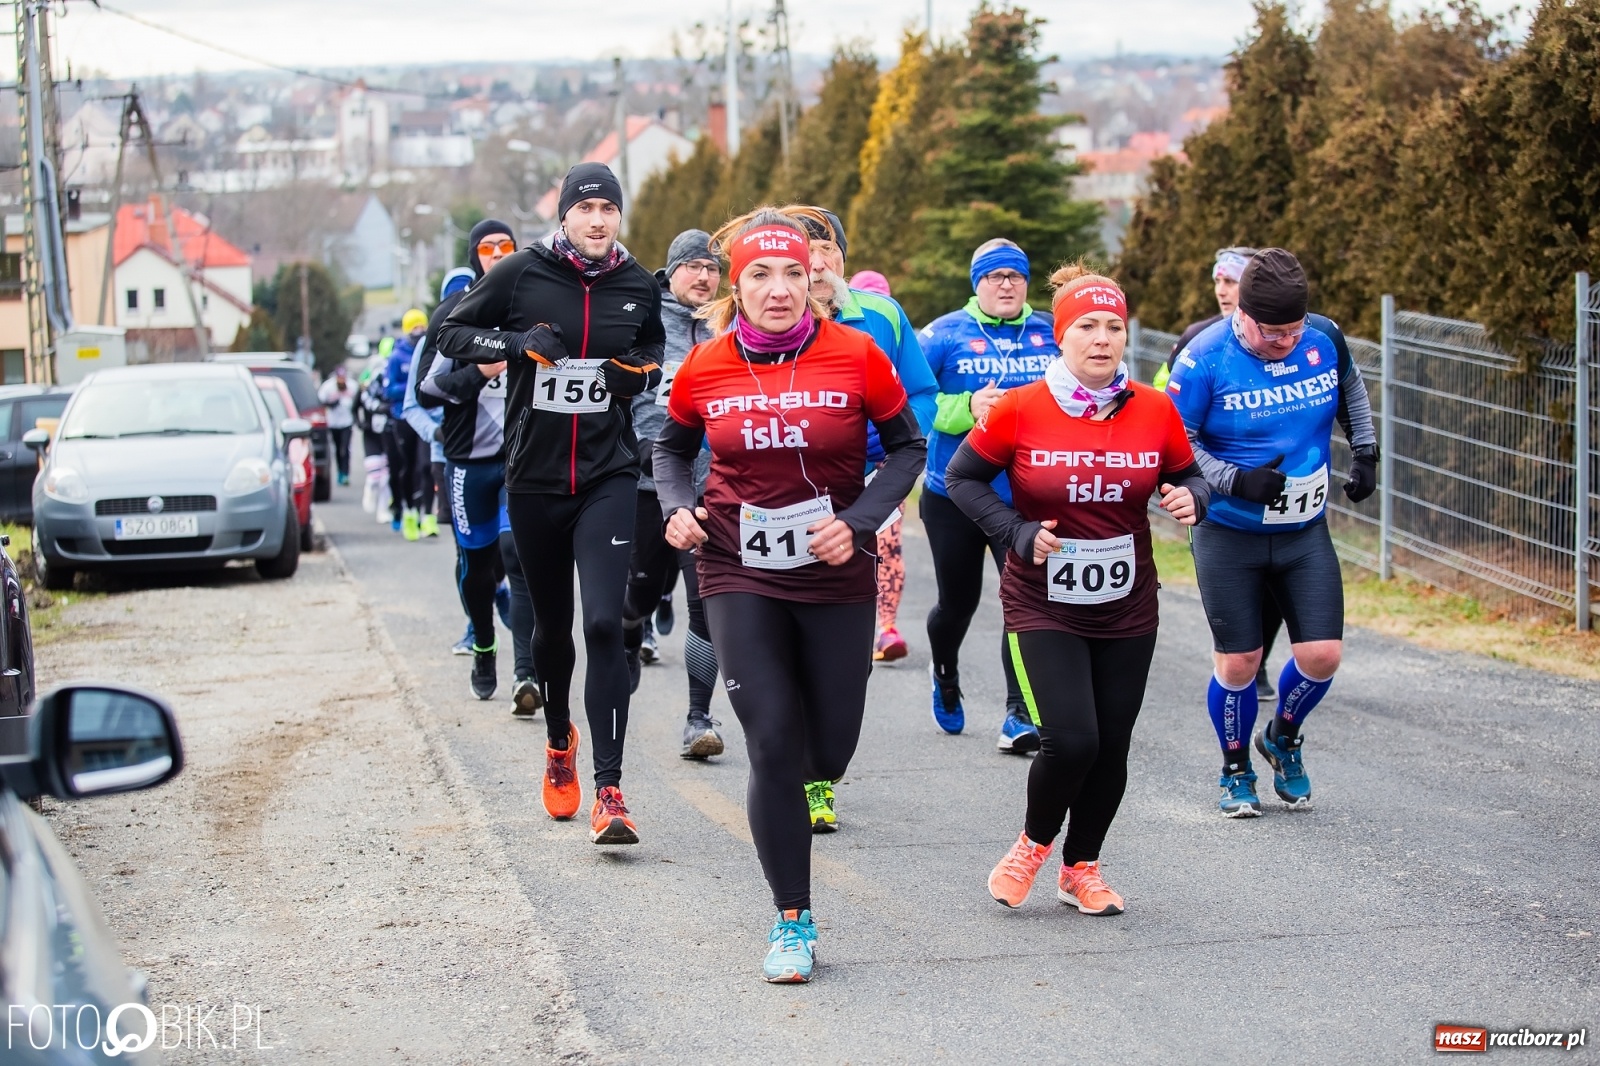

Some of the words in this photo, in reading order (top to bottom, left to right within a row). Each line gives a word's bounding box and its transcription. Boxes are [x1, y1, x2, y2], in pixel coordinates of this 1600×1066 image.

[622, 302, 637, 312] 4F
[541, 377, 607, 403] 156
[1223, 368, 1338, 411] RUNNERS
[1309, 394, 1333, 408] TEAM
[706, 391, 848, 418] DAR-BUD
[1030, 450, 1160, 468] DAR-BUD
[453, 466, 472, 536] RUNNERS
[1268, 484, 1325, 515] 415
[125, 518, 156, 536] SZO
[1052, 560, 1130, 592] 409
